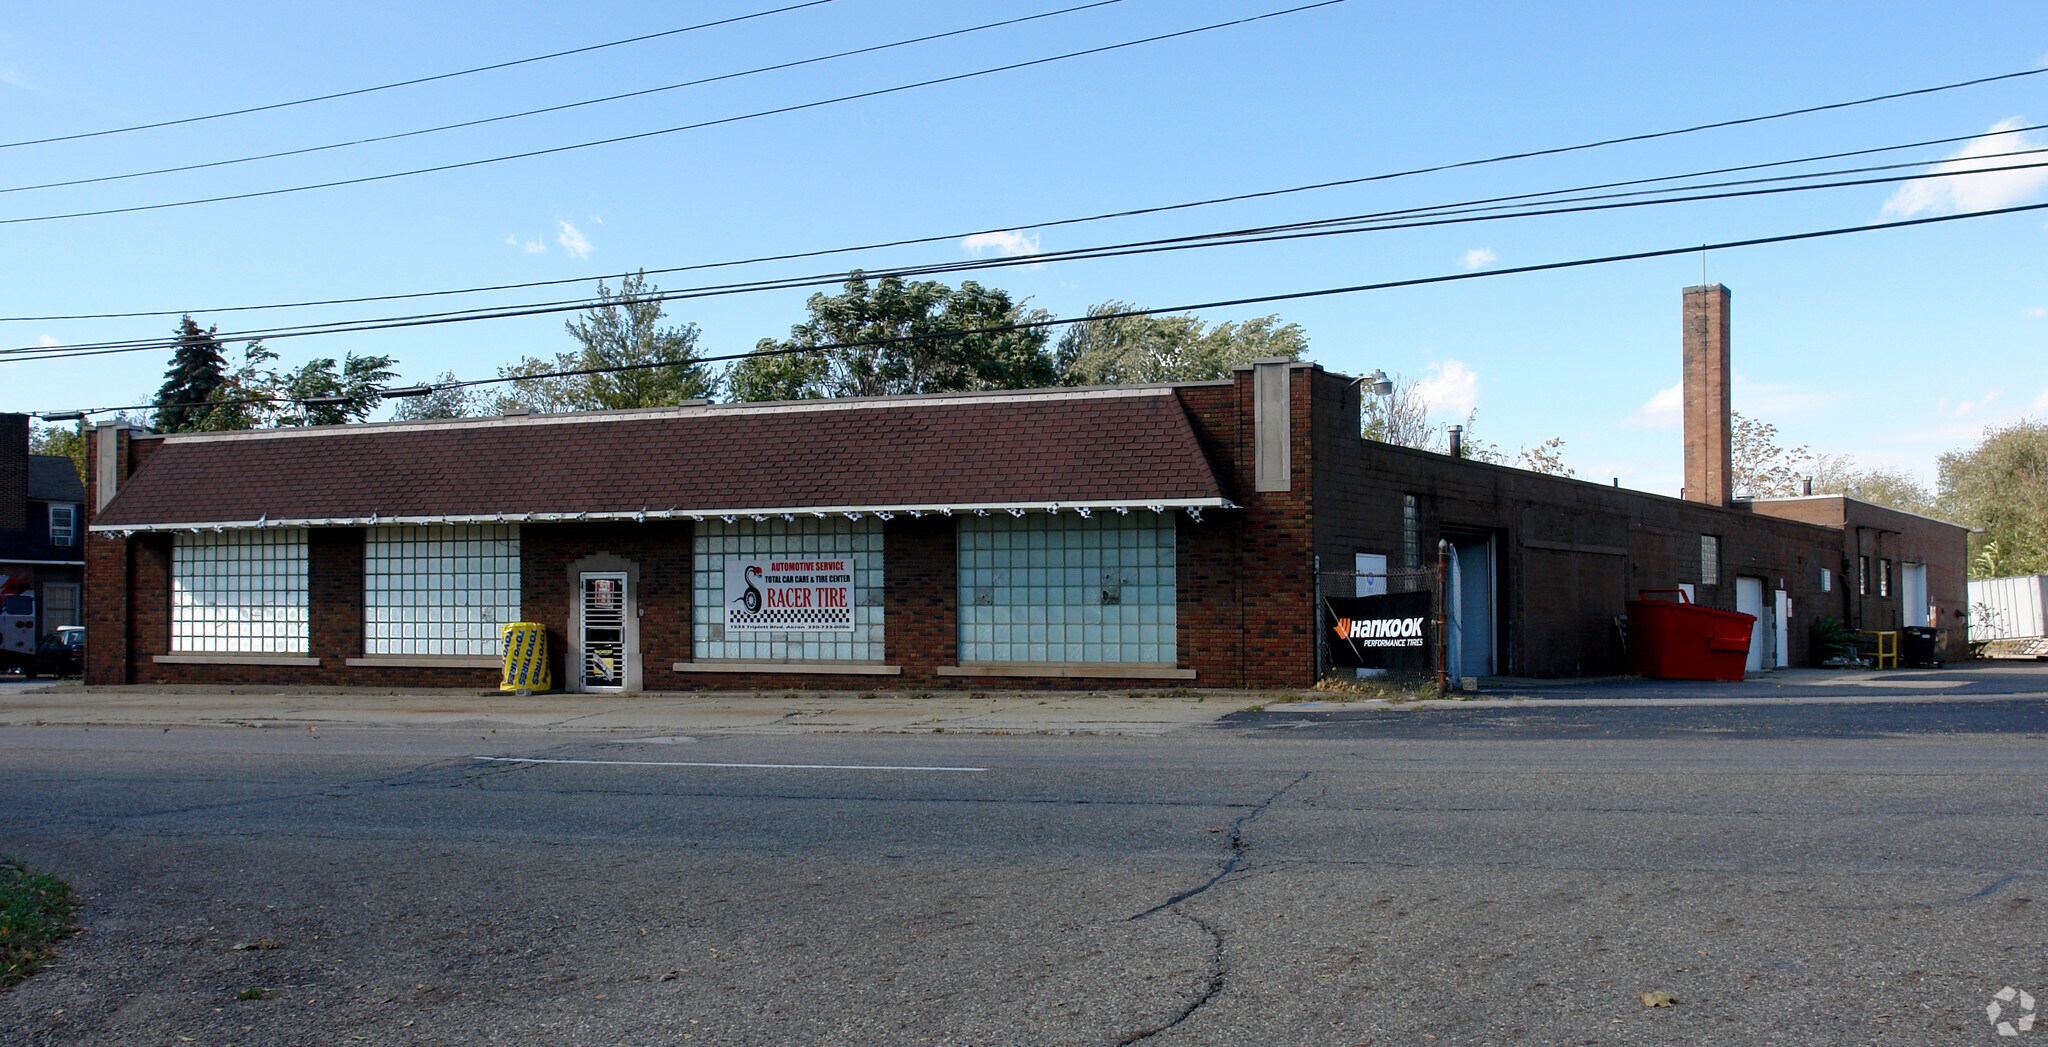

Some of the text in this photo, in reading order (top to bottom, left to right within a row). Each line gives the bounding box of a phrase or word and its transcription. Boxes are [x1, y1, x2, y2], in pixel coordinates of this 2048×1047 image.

[771, 561, 844, 572] AUTOMOTIVE SERVICE
[816, 575, 828, 583] TIRE
[829, 575, 851, 583] CENTER
[767, 587, 848, 608] RACER TIRE
[1363, 638, 1423, 647] PERFORMANCE TIRES
[519, 630, 537, 686] TOYO TIRES
